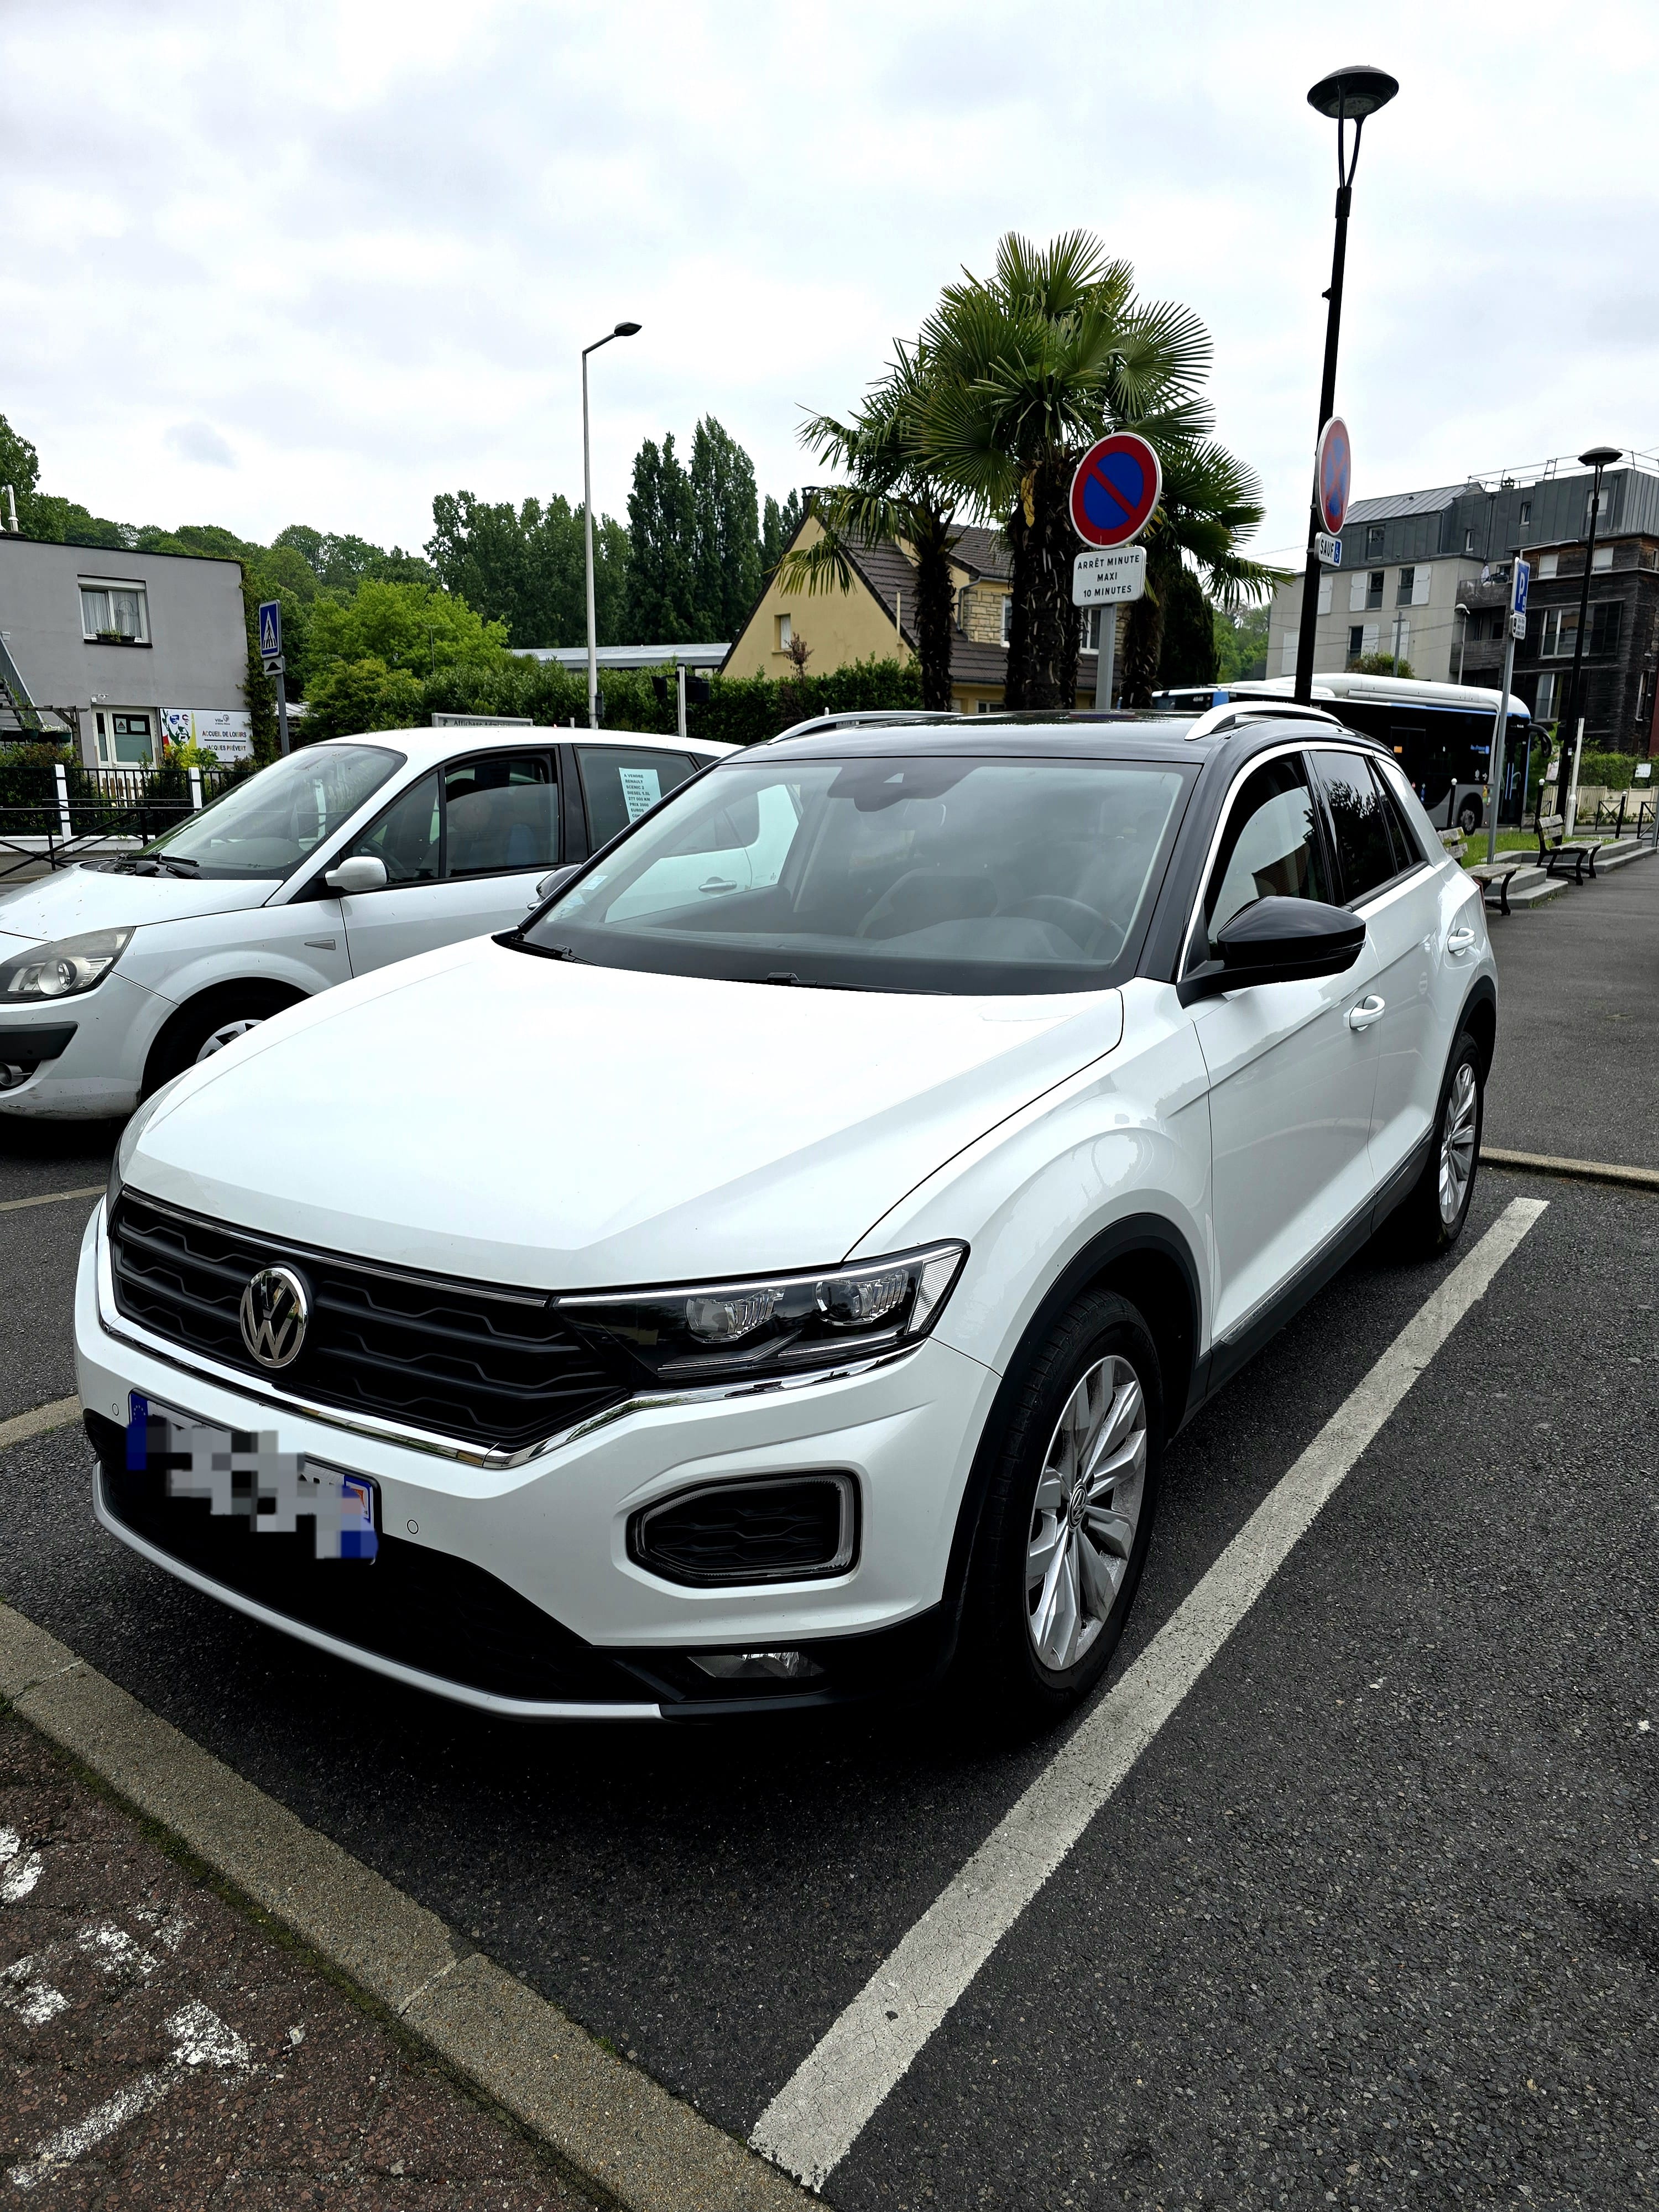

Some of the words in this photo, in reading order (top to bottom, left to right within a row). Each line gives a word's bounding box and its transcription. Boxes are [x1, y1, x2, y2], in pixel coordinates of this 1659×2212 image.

[1320, 539, 1334, 558] SAUF
[1077, 558, 1104, 570] ARRÊT
[1107, 555, 1140, 566] MINUTE
[1097, 572, 1118, 582] MAXI
[1083, 589, 1092, 598] 10
[1094, 585, 1132, 596] MINUTES
[1517, 571, 1525, 604] P
